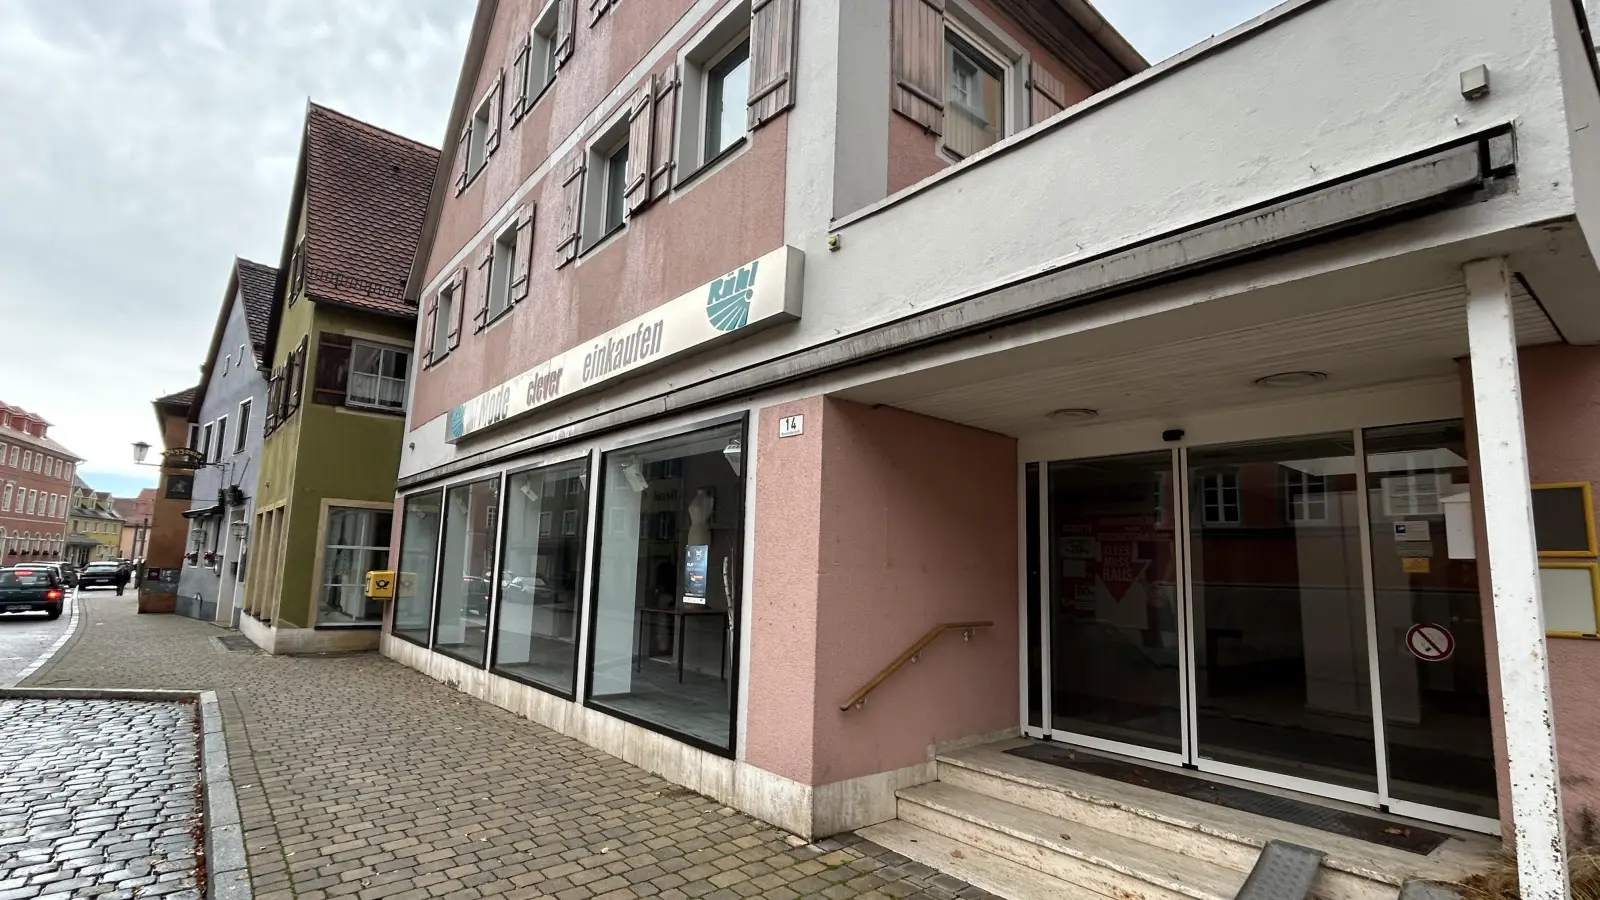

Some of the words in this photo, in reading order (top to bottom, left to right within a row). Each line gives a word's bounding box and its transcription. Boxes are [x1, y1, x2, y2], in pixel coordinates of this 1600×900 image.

[526, 367, 564, 406] clever
[582, 319, 664, 383] einkaufen
[786, 416, 796, 431] 14
